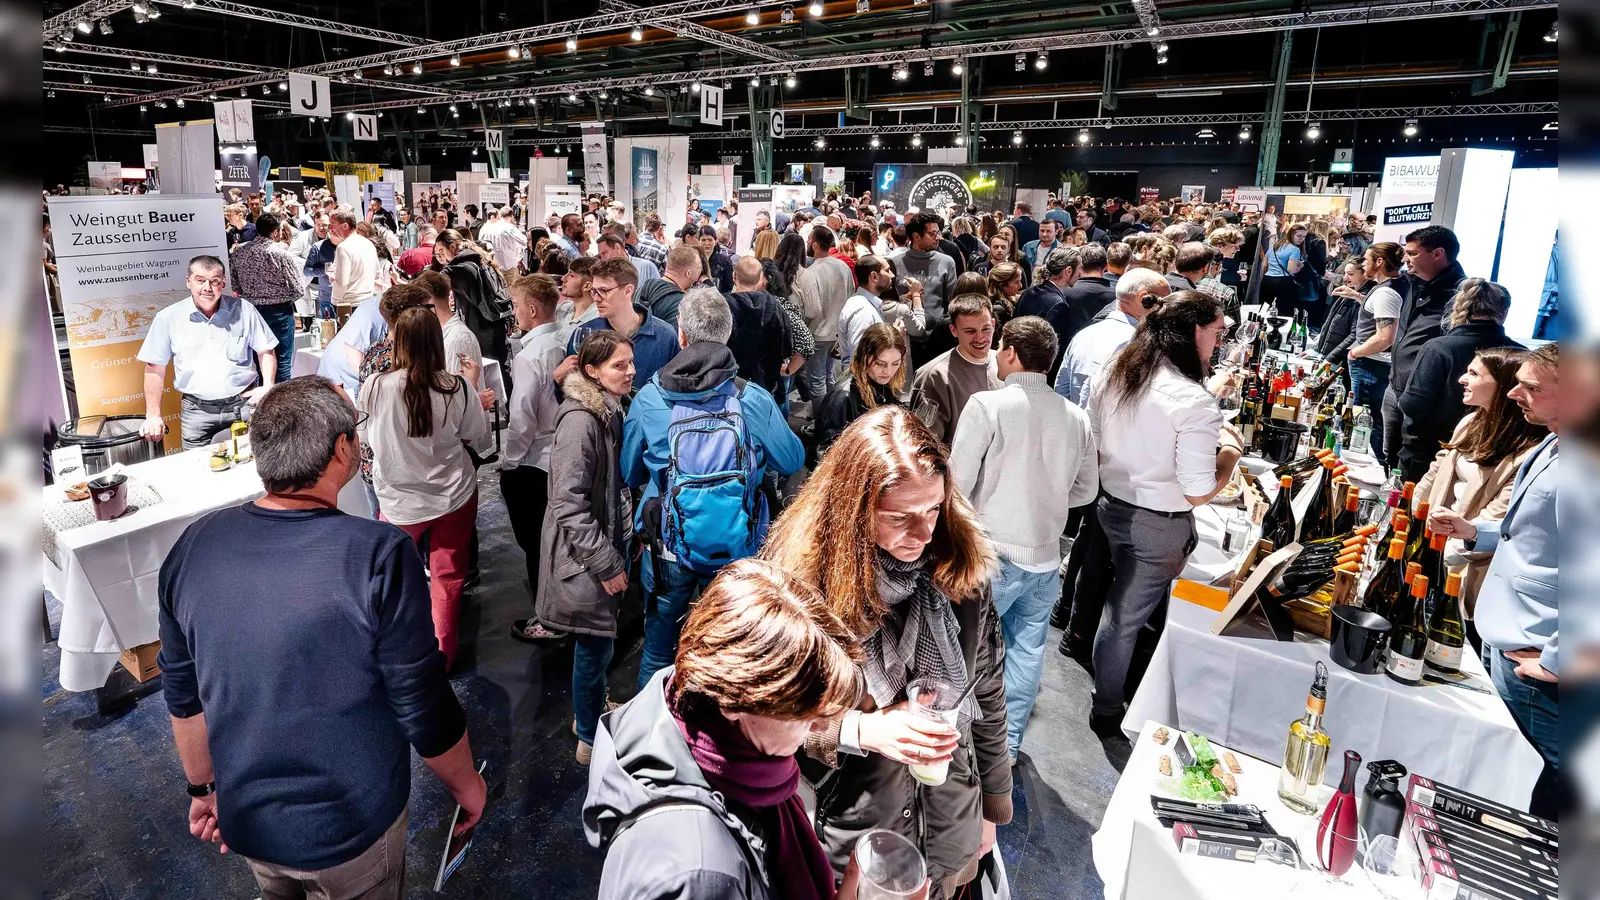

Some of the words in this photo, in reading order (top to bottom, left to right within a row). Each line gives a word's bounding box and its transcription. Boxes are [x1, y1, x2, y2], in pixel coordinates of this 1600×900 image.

[301, 80, 317, 110] J
[705, 90, 719, 120] H
[358, 118, 373, 137] N
[771, 111, 783, 136] G
[488, 132, 500, 148] M
[1341, 151, 1346, 159] 9
[228, 165, 250, 179] ZETER
[918, 179, 963, 198] WINZINGER
[1411, 204, 1430, 213] CALL
[70, 212, 144, 228] Weingut
[148, 211, 195, 223] Bauer
[72, 229, 177, 246] Zaussenberg
[76, 261, 144, 274] Weinbaugebiet
[145, 259, 180, 269] Wagram
[78, 271, 169, 286] www.zaussenberg.at
[90, 357, 133, 370] Grüner
